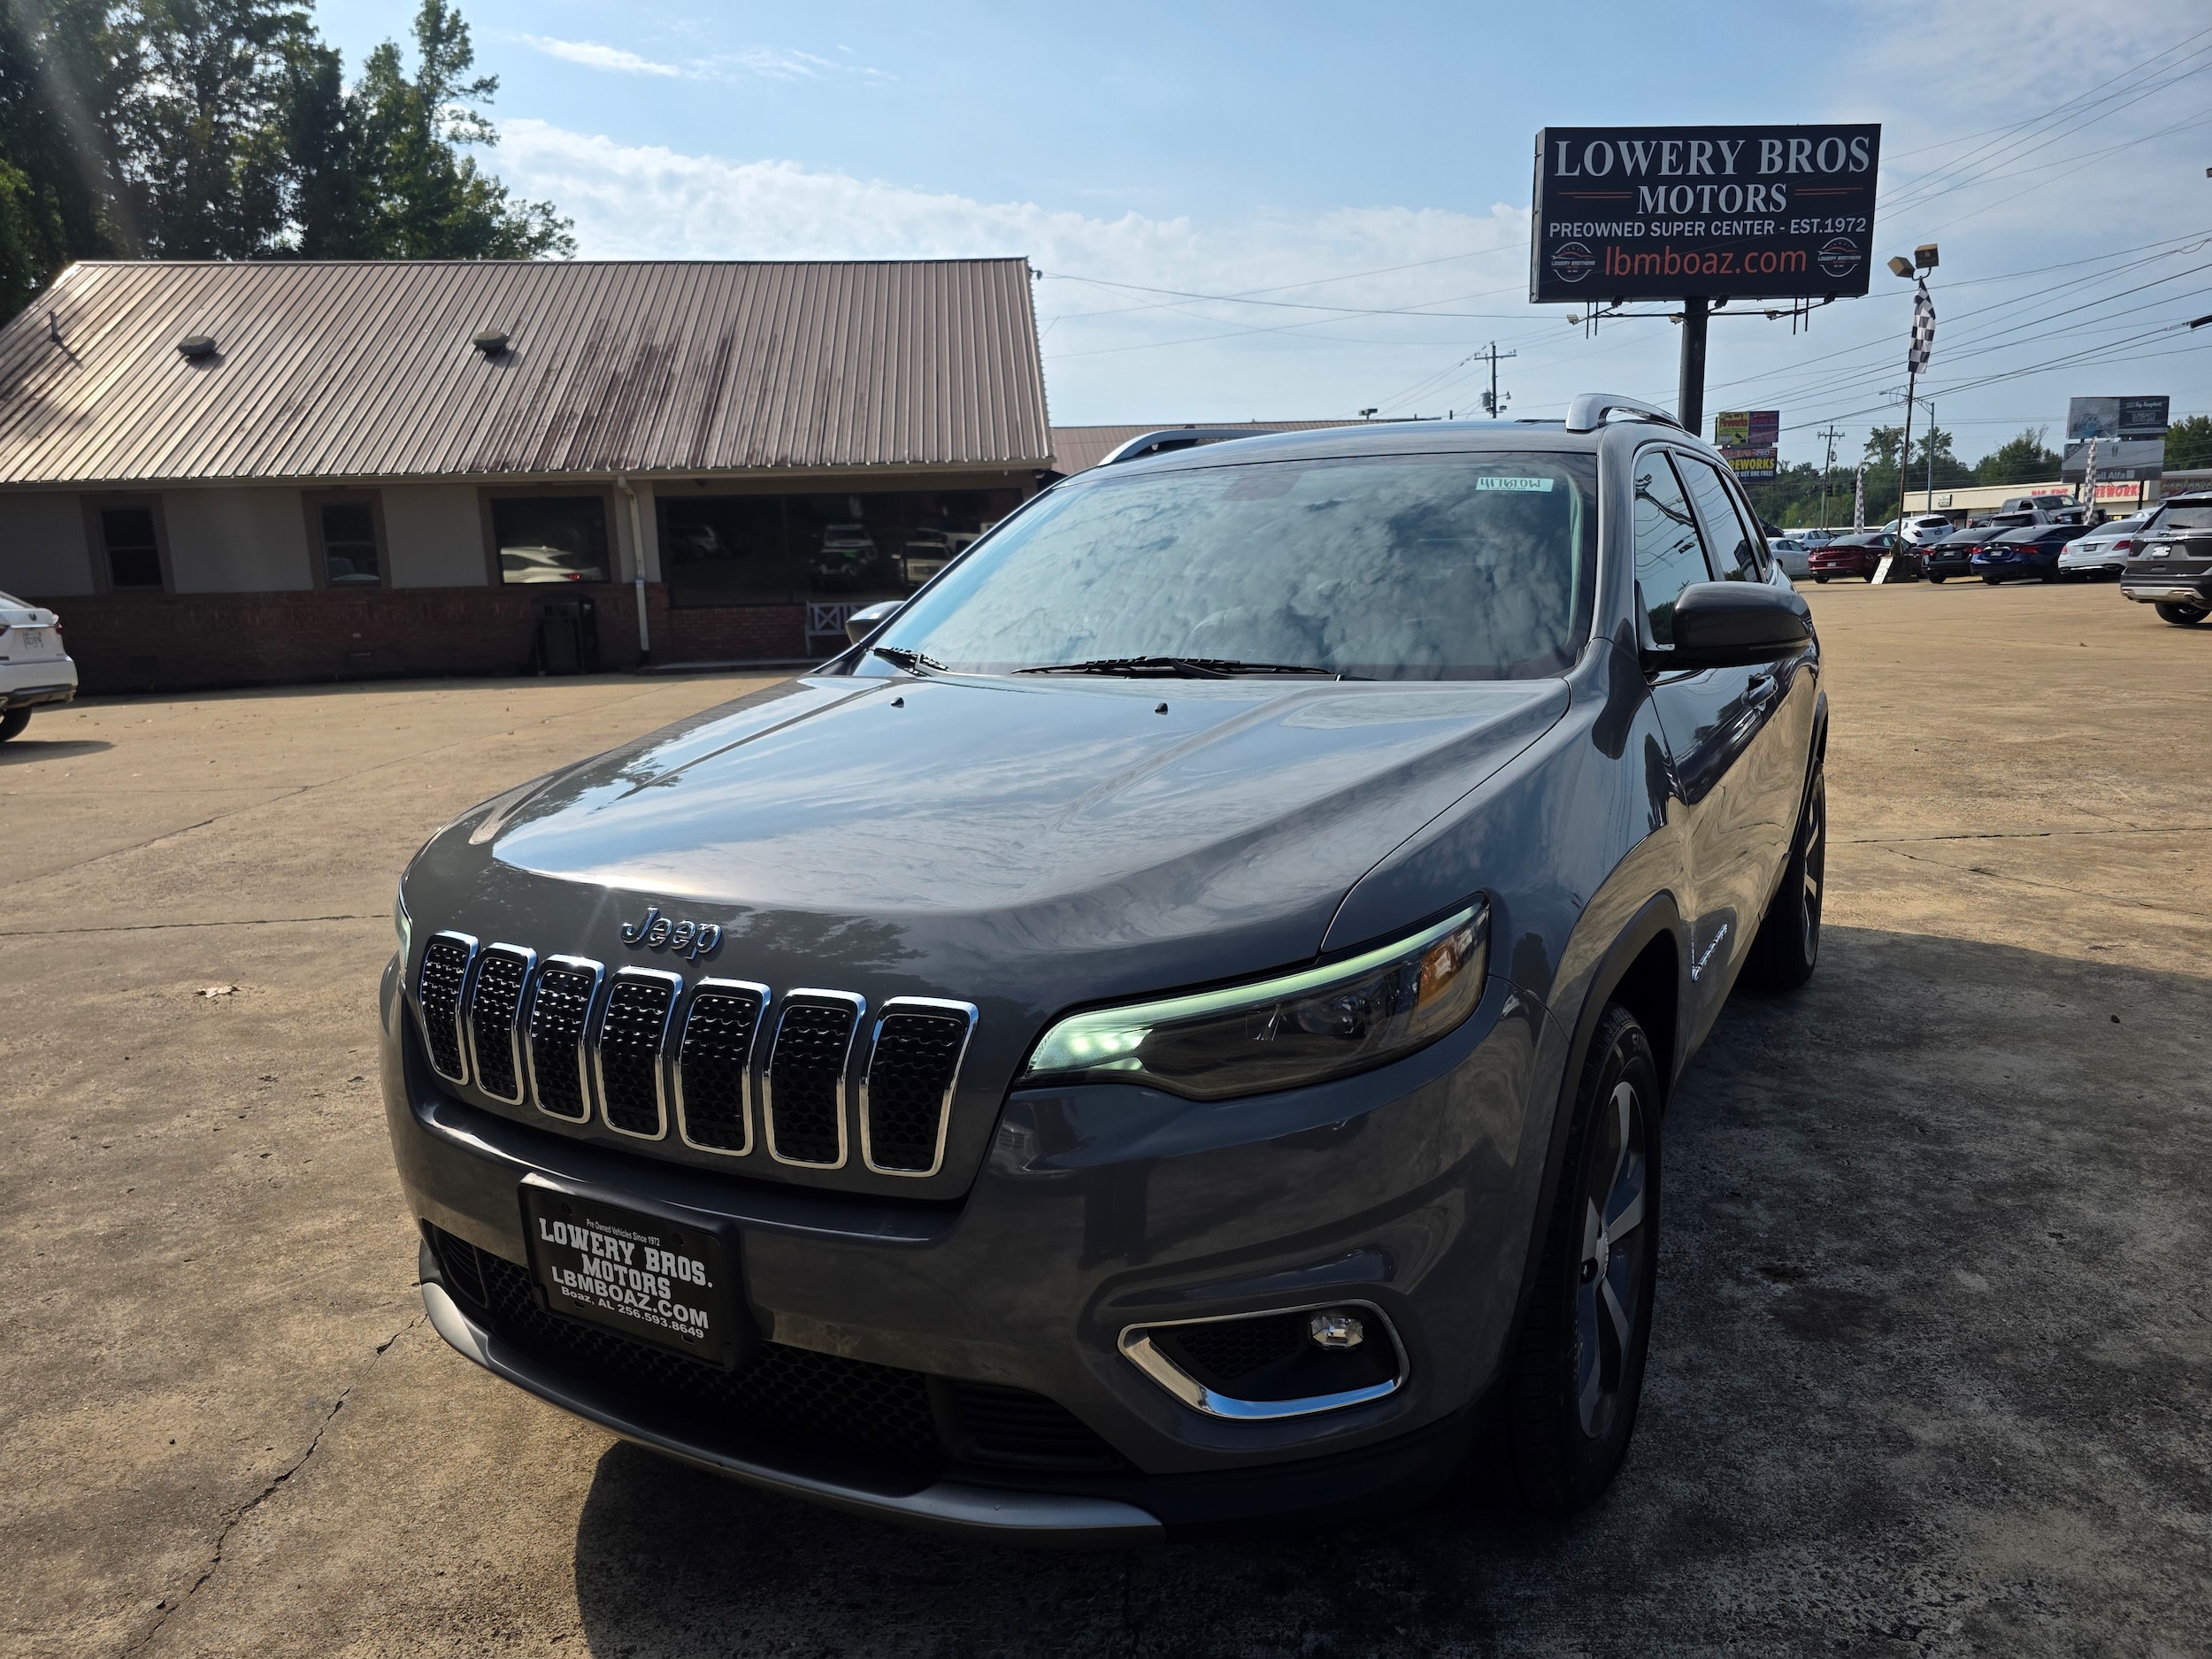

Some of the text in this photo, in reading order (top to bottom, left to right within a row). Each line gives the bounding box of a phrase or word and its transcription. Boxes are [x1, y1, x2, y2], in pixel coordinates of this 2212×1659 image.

[1554, 135, 1870, 177] LOWERY BROS
[1636, 182, 1788, 215] MOTORS
[1549, 221, 1646, 238] PREOWNED
[1650, 220, 1706, 237] SUPER
[1710, 219, 1775, 235] CENTER
[1790, 217, 1867, 234] EST.1972
[1604, 245, 1807, 276] lbmboaz.com
[1728, 458, 1775, 471] REWORKS
[2107, 471, 2126, 480] Alfa
[621, 906, 723, 960] Jeep
[586, 1217, 661, 1247] Pre Owned Vehicles Since 1972
[538, 1217, 713, 1288] LOWERY BROS.
[581, 1253, 672, 1300] MOTORS
[551, 1265, 710, 1329] LBMBOAZ.COM
[561, 1286, 704, 1339] Boaz, AL 256.593.8649
